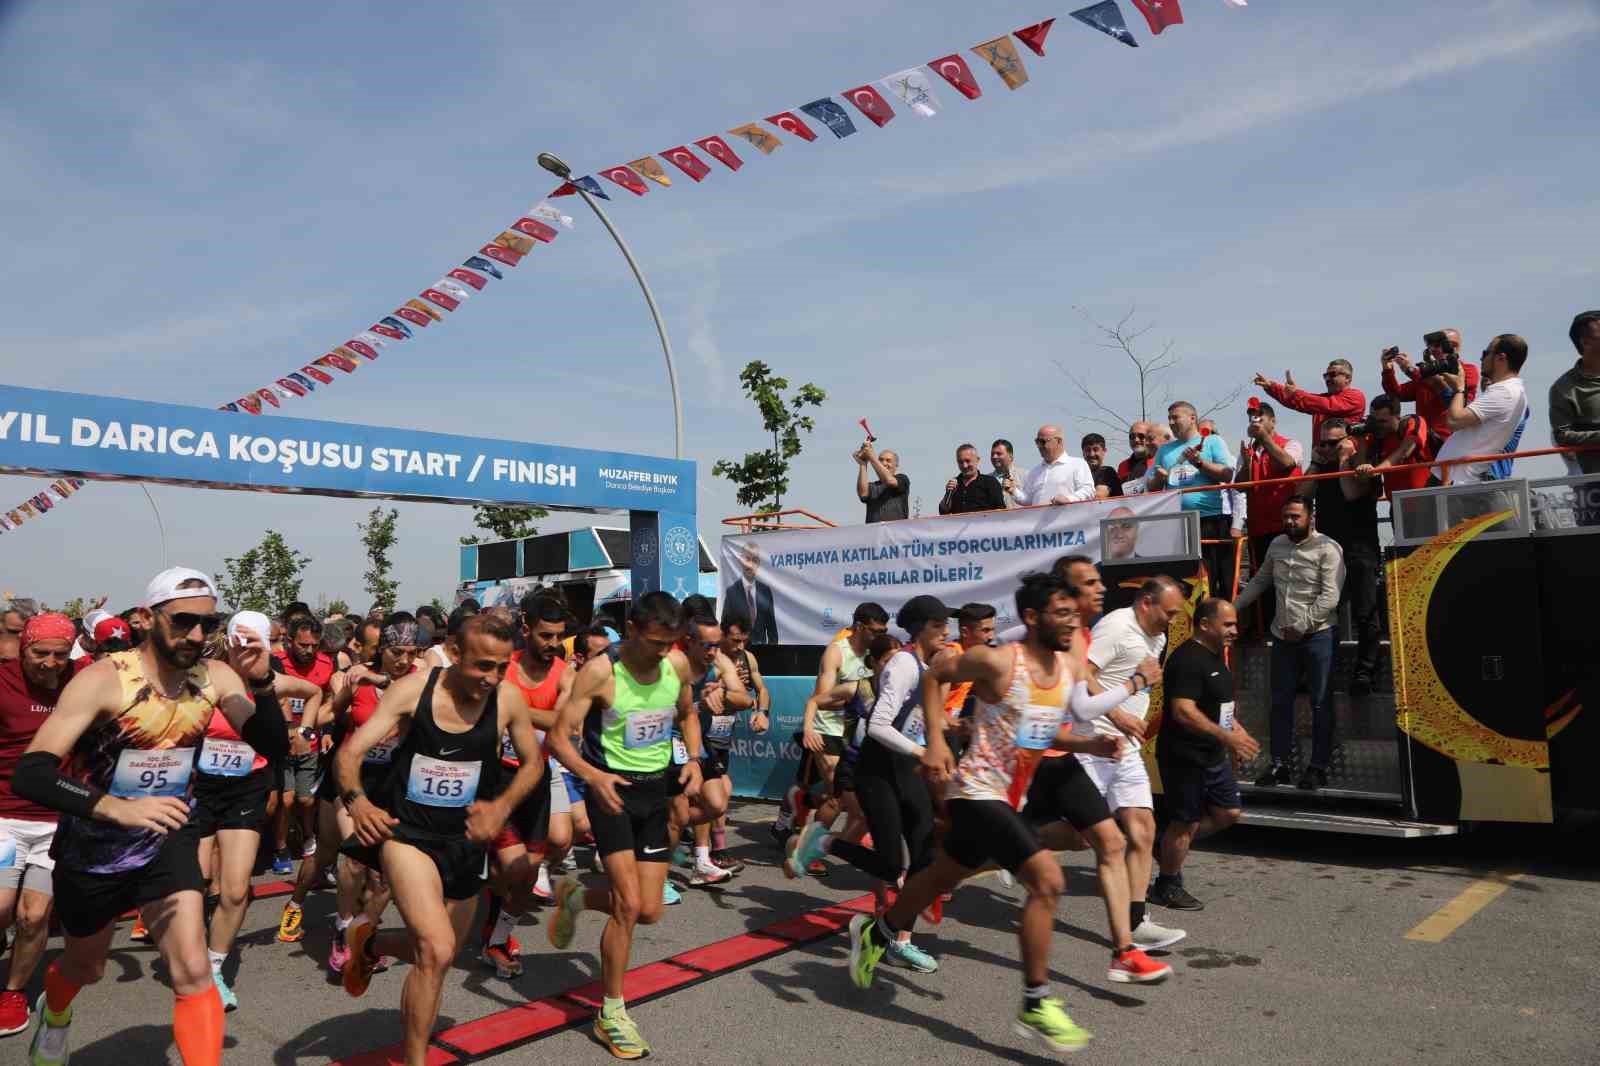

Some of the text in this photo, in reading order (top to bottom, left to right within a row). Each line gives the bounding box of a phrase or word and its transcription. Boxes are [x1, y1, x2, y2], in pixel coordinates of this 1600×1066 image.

[71, 417, 220, 458] DARICA
[229, 433, 363, 474] KOŞUSU
[370, 447, 462, 478] START
[492, 458, 577, 488] FINISH
[599, 468, 678, 485] MUZAFFER BIYIK
[770, 530, 1086, 569] YARIŞMAYA KATILAN TÜM SPORCULARIMIZA
[844, 562, 983, 589] BAŞARILAR DİLERİZ
[210, 752, 243, 769] 174
[138, 770, 168, 789] 95
[422, 777, 464, 797] 163
